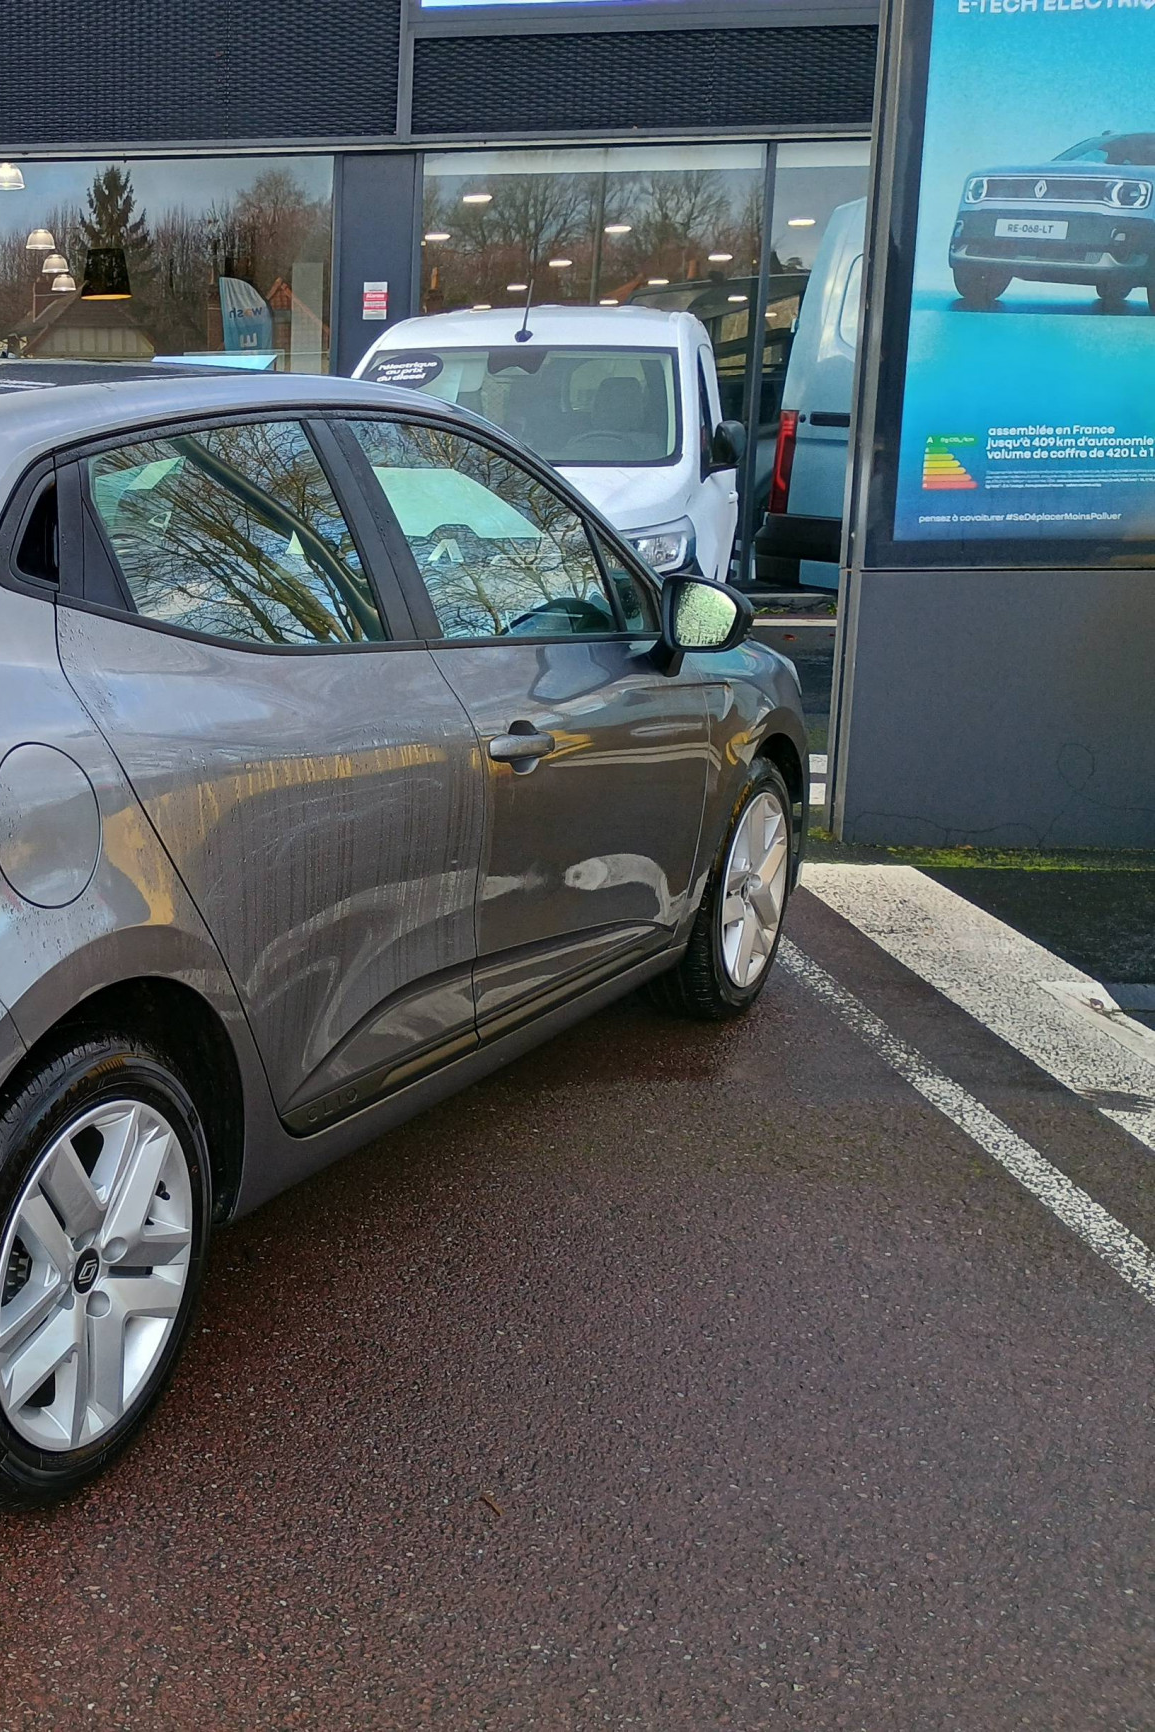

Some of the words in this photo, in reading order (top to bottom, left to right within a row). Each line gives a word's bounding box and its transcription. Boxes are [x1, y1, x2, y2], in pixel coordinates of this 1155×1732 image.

[958, 0, 1037, 13] E-TECH
[988, 425, 1054, 436] assemblée
[1055, 427, 1071, 435] en
[1072, 425, 1115, 435] France
[1032, 437, 1055, 447] 409
[1056, 436, 1075, 446] km
[1077, 435, 1154, 446] d'autonomie
[987, 449, 1031, 459] volume
[1033, 448, 1048, 458] de
[1049, 448, 1087, 458] coffre
[1089, 448, 1104, 458] de
[1106, 448, 1129, 458] 420
[1130, 448, 1138, 457] L
[1139, 446, 1147, 457] à
